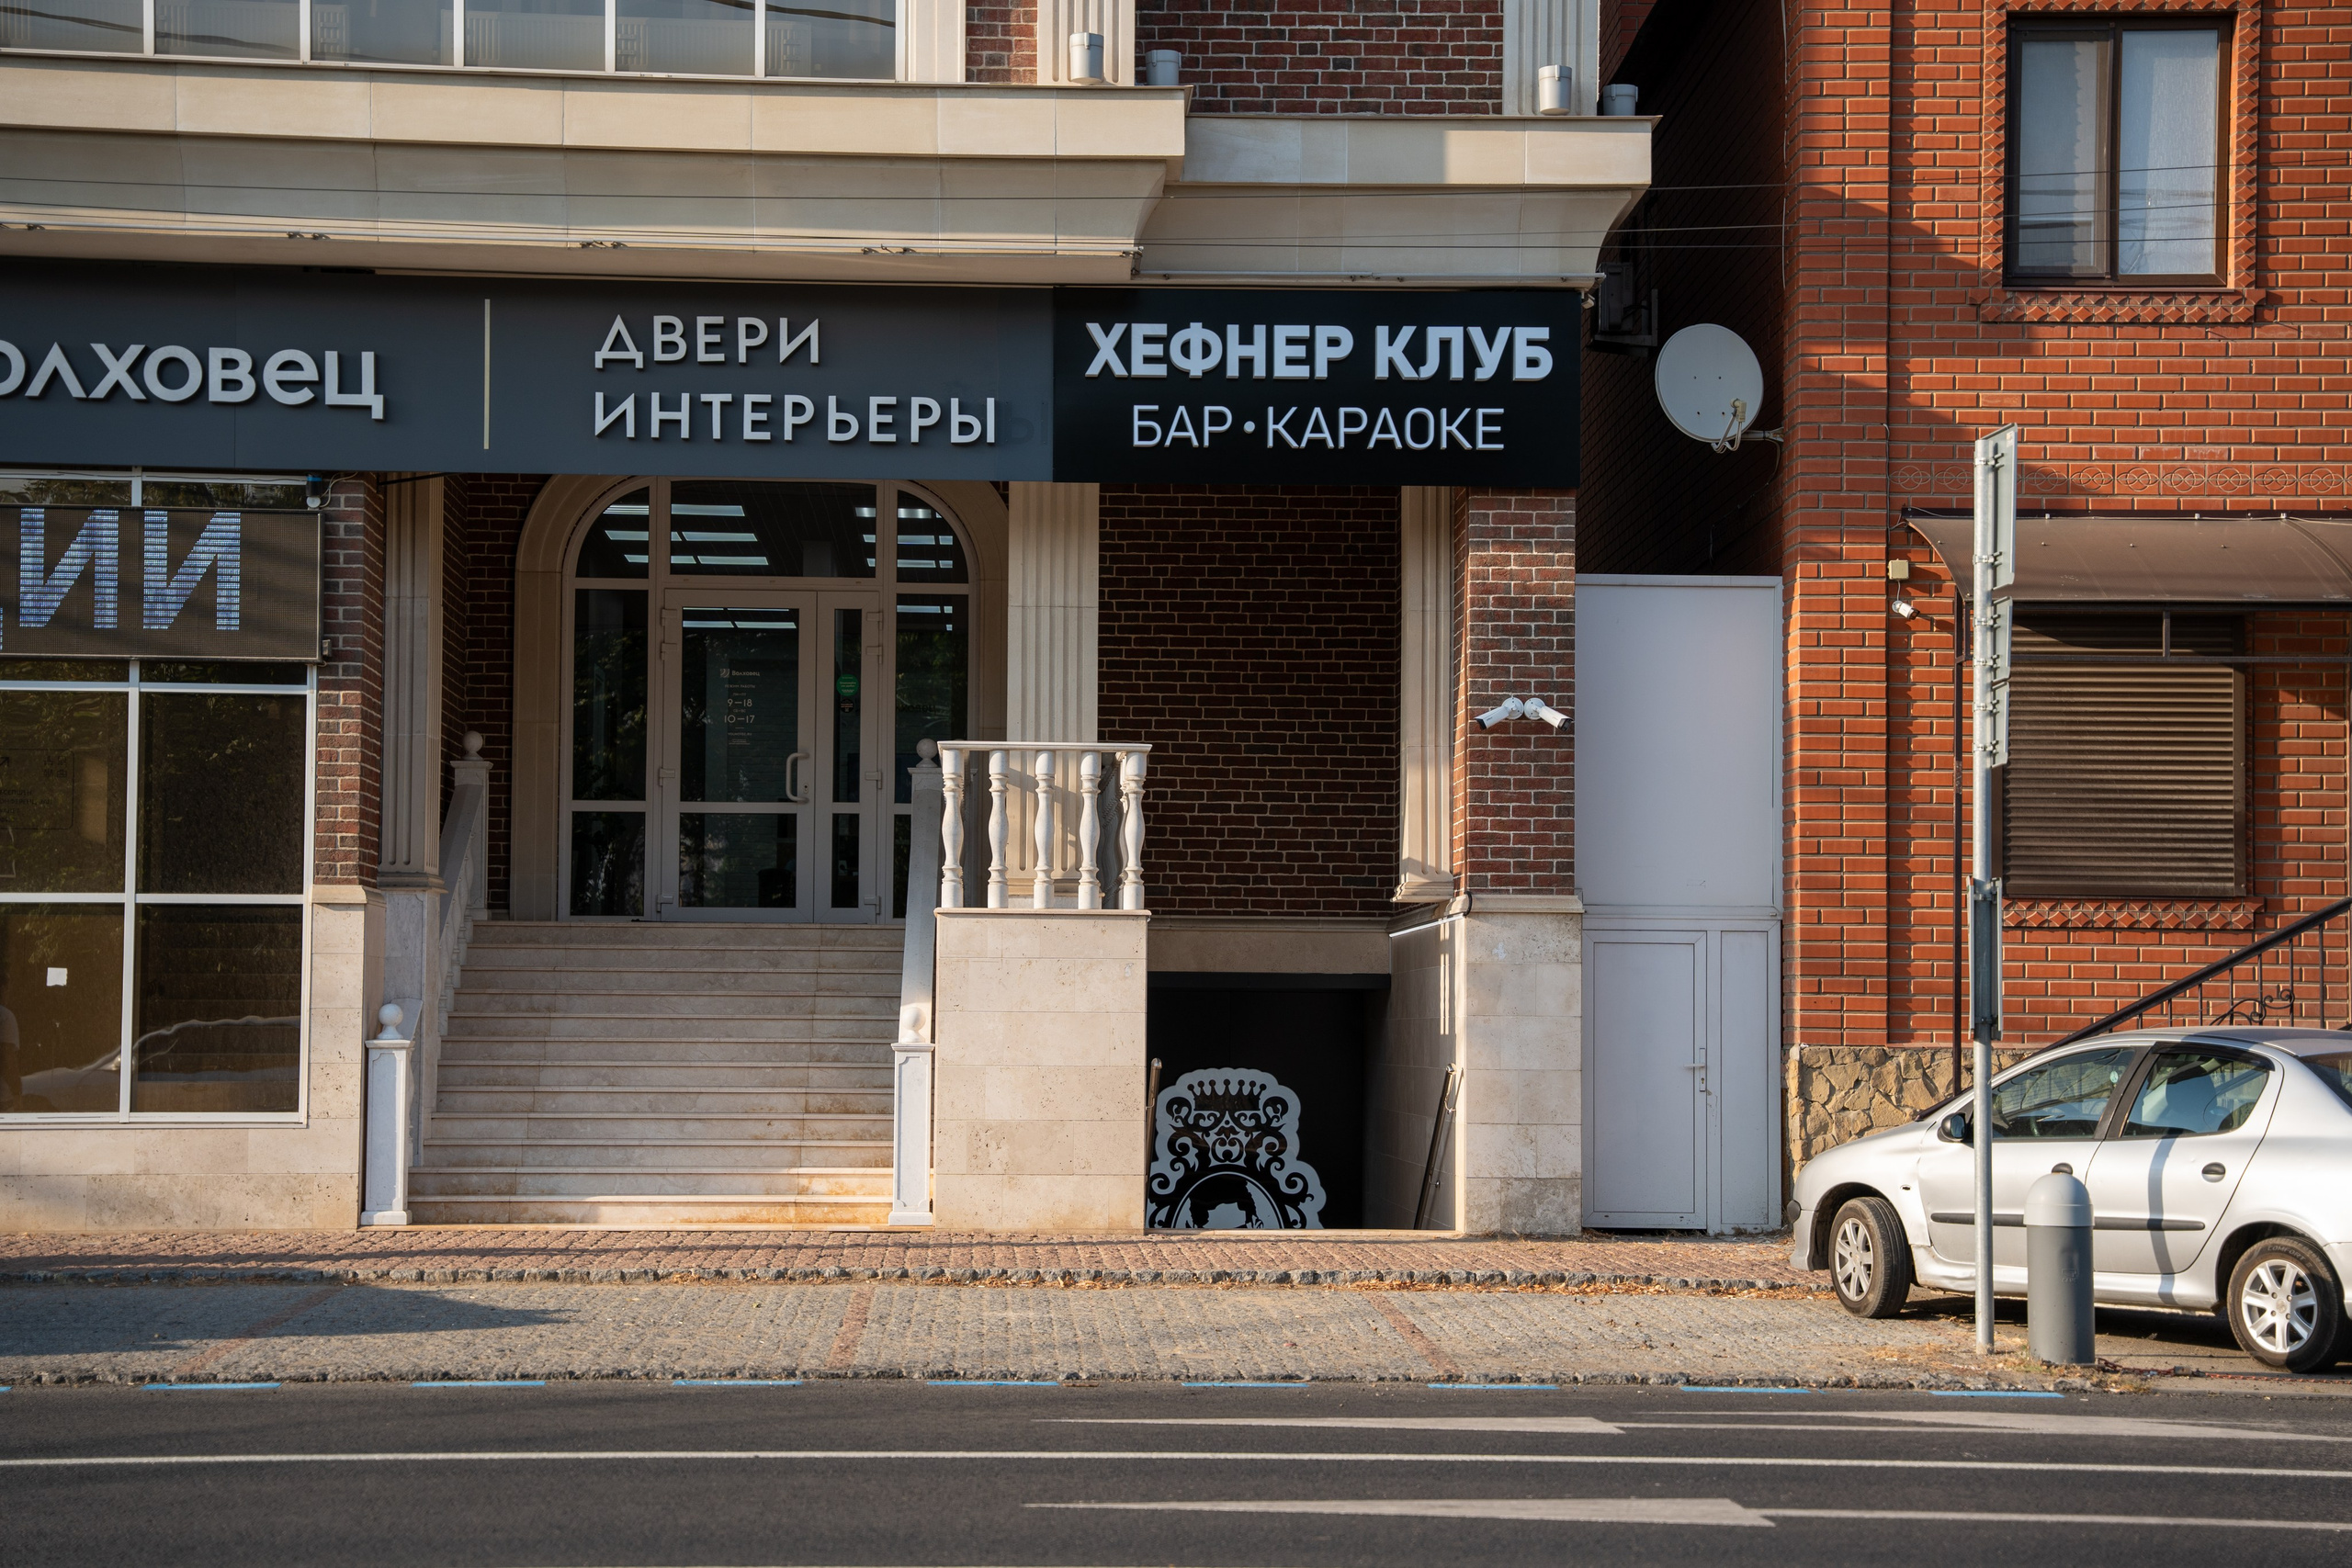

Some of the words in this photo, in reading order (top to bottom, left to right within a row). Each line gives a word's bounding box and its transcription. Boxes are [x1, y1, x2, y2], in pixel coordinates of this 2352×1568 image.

[594, 314, 820, 368] ДВЕРИ
[1085, 321, 1355, 378] ХЕФНЕР
[1374, 325, 1554, 381] КЛУБ
[594, 391, 996, 444] ИНТЕРЬЕРЫ
[1267, 406, 1505, 450] КАРАОКЕ
[2267, 1246, 2306, 1260] COMFORT
